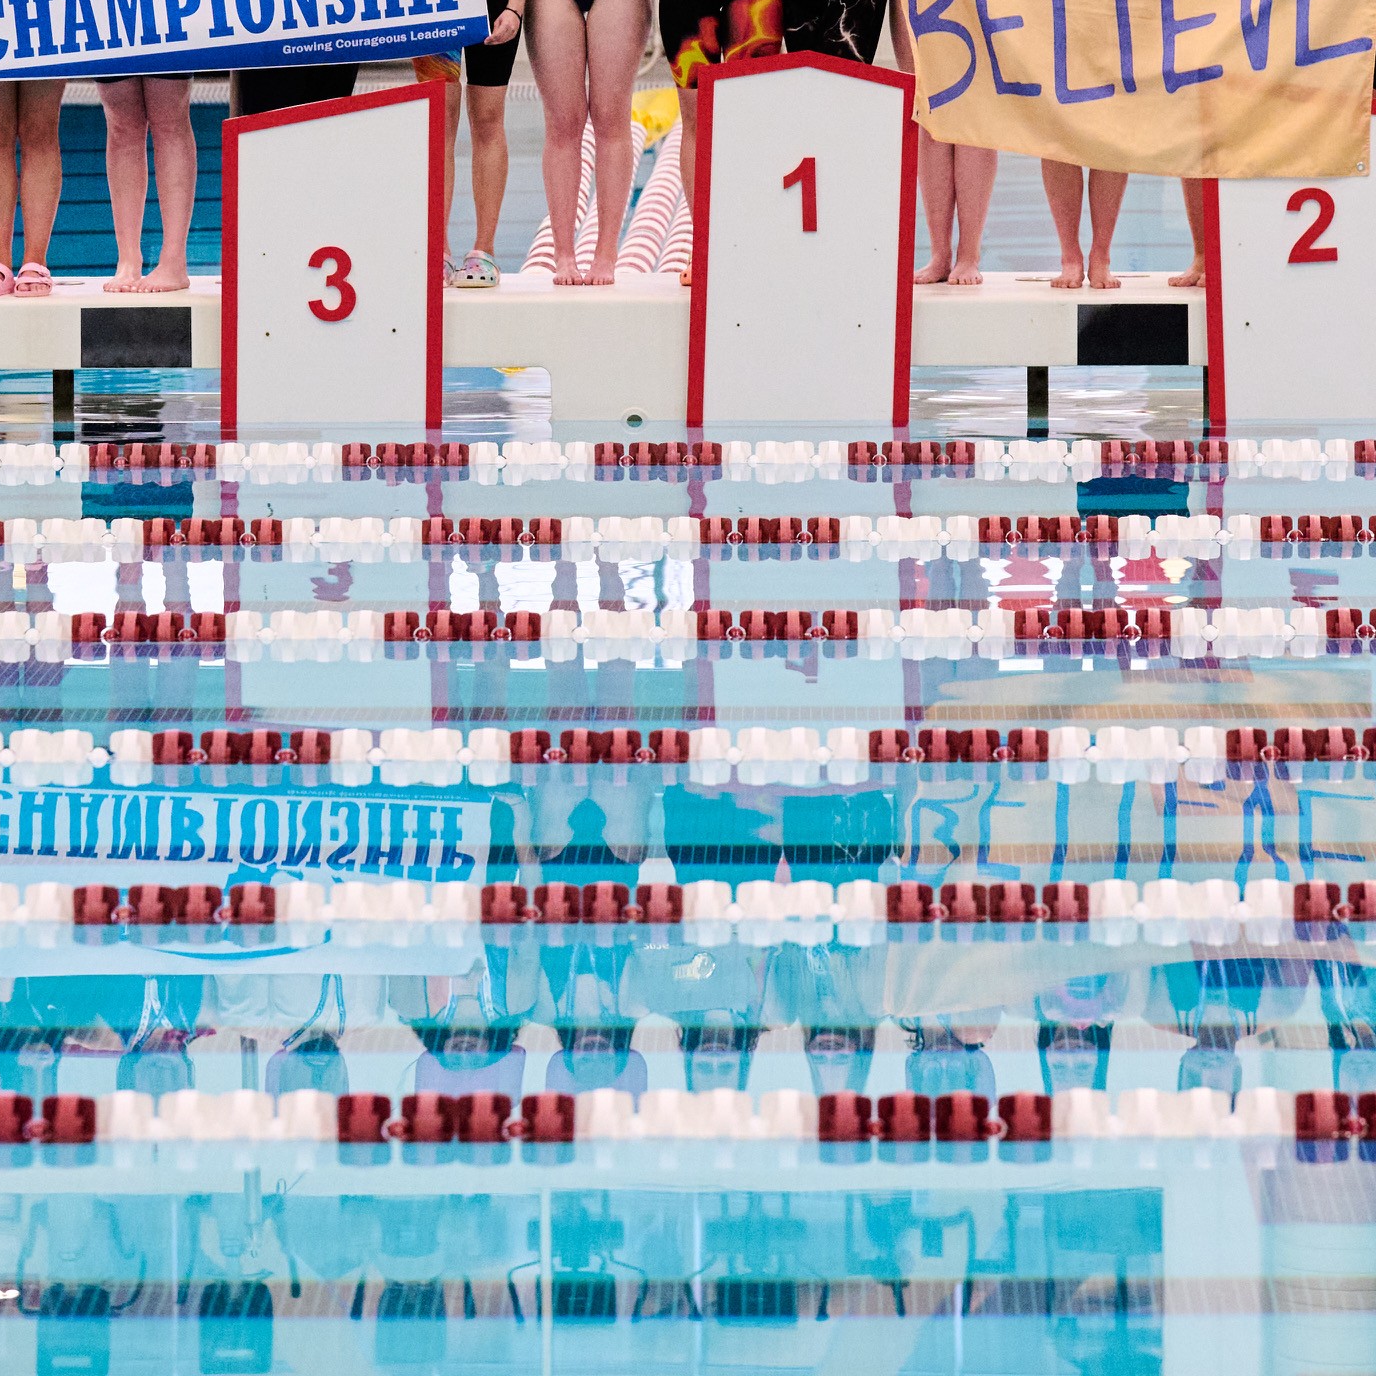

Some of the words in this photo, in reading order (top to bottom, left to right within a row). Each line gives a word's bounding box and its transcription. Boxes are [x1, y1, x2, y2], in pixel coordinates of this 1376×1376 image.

[282, 40, 333, 55] Growing
[335, 33, 407, 48] Courageous
[782, 157, 817, 232] 1
[1286, 188, 1339, 265] 2
[308, 246, 357, 322] 3
